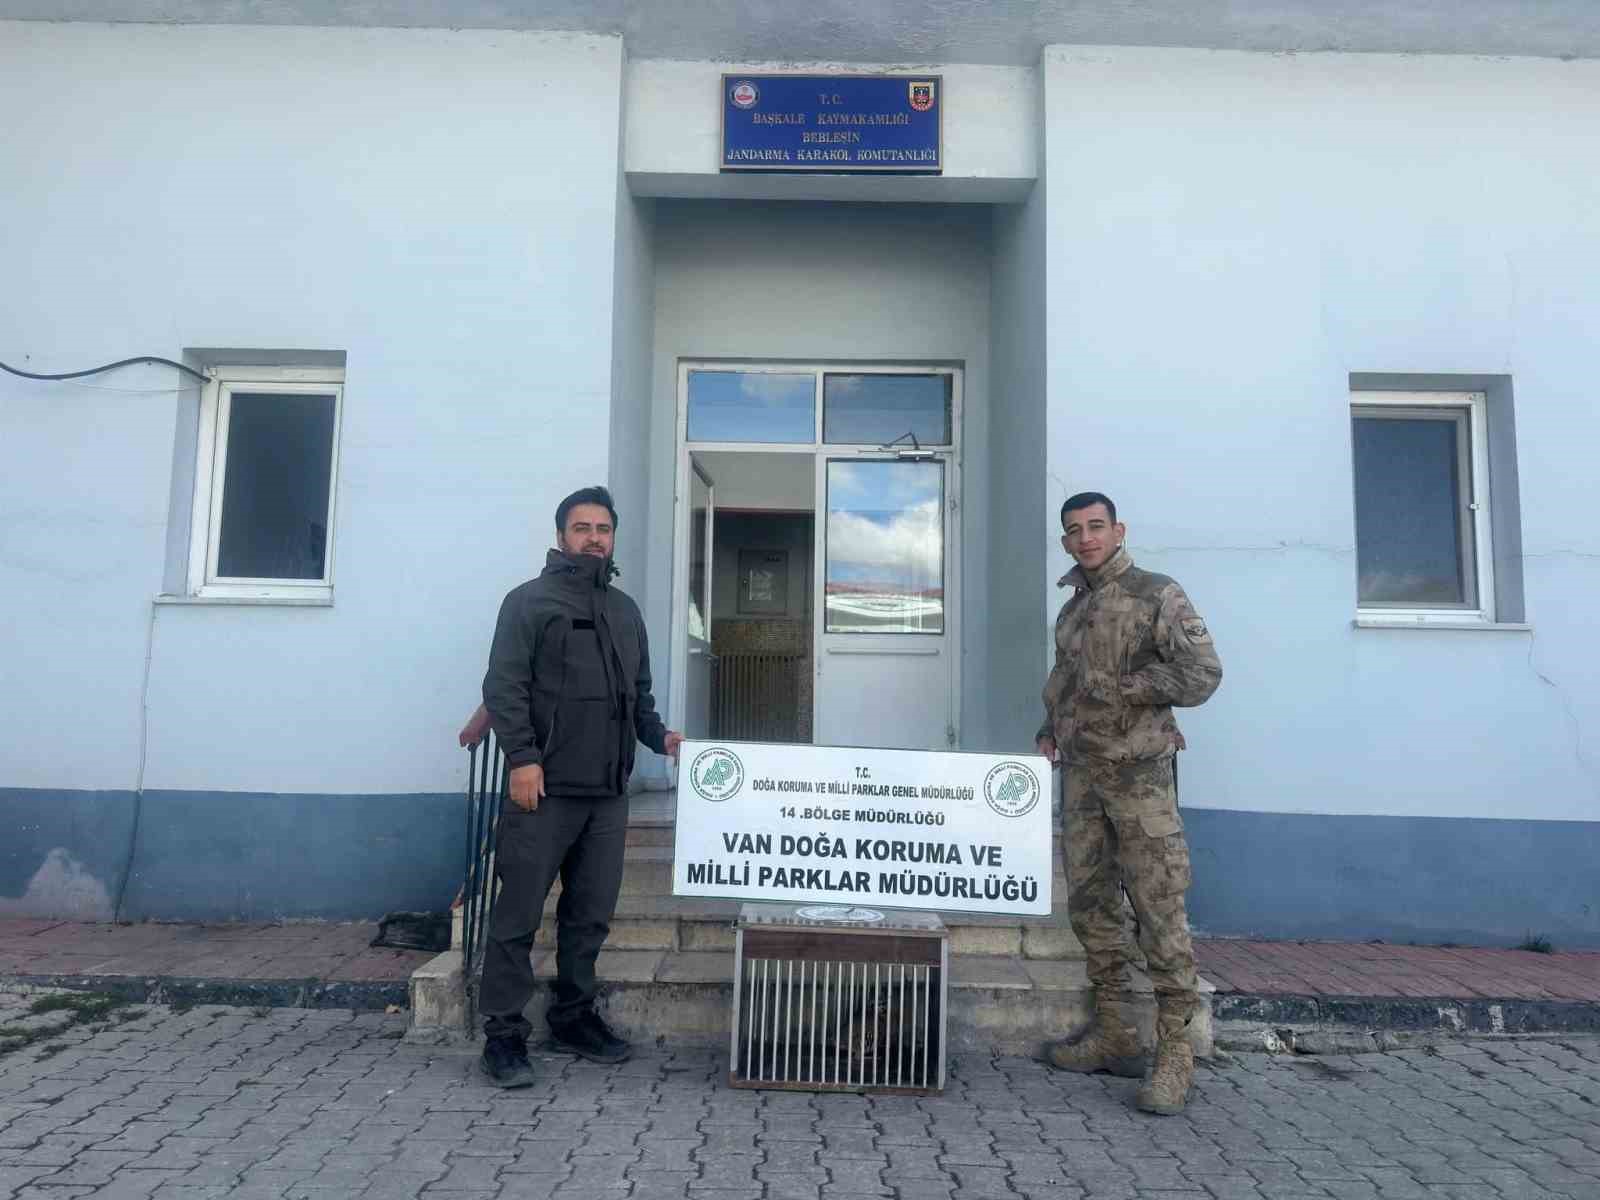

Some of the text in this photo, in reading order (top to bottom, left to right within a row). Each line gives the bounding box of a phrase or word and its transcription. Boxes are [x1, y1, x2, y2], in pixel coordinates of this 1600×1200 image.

[753, 111, 910, 127] BAŞKALE KAYMAKAMLIĞI
[727, 147, 936, 161] JANDARMA KARAKOL KOMUTANLIĞI
[855, 766, 871, 779] T.C.
[752, 776, 975, 801] DOĞA KORUMA VE MİLLİ PARKLAR GENEL MÜDÜRLÜĞÜ
[779, 806, 796, 819] 14
[855, 807, 945, 826] MÜDÜRLÜĞÜ
[722, 832, 1003, 867] VAN DOĞA KORUMA VE
[687, 859, 1038, 903] MİLLİ PARKLAR MÜDÜRLÜĞÜ
